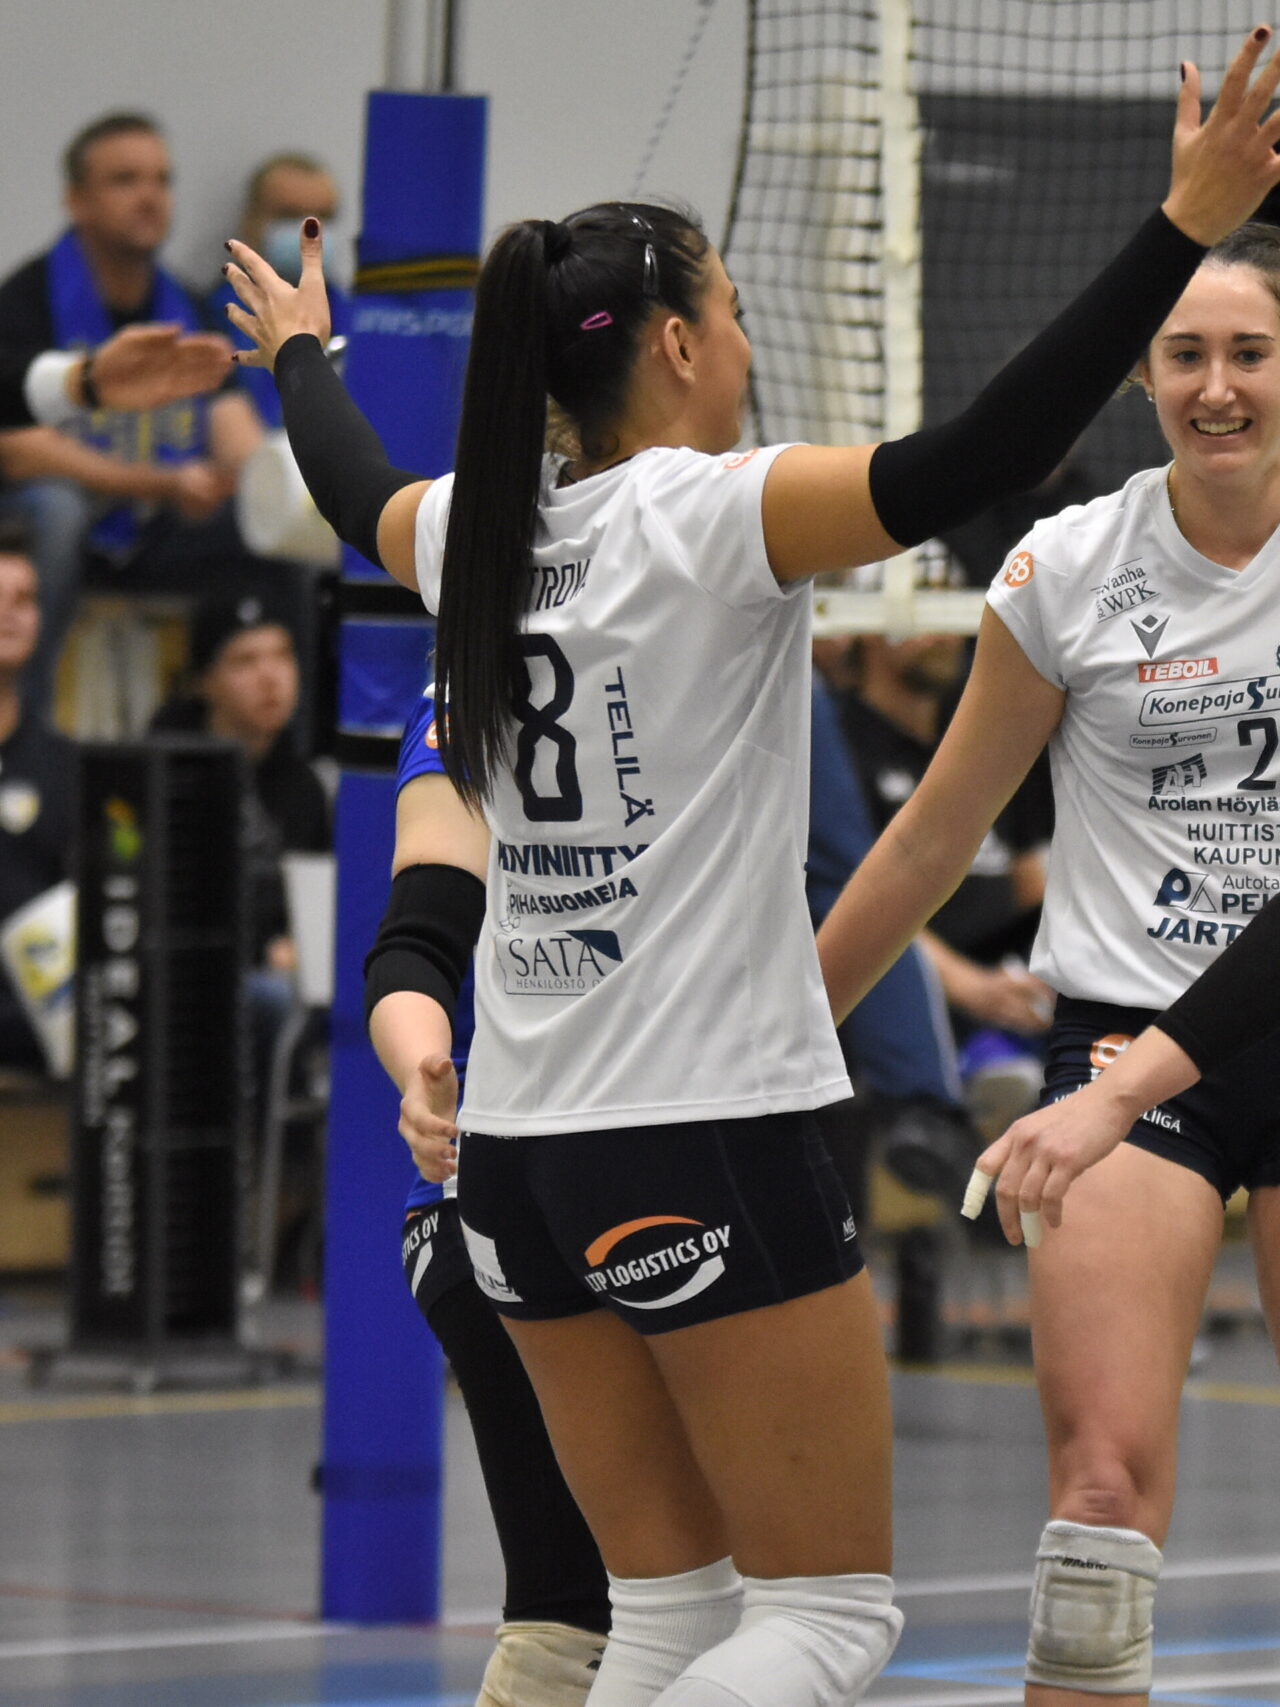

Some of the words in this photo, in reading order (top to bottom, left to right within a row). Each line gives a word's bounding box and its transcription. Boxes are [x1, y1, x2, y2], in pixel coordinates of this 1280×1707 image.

[1104, 567, 1147, 592] Vanha
[1143, 660, 1213, 681] TEBOIL
[1149, 689, 1245, 715] Konepaja
[512, 633, 583, 822] 8
[604, 666, 655, 828] TELILÄ
[1237, 717, 1279, 791] 2
[1148, 795, 1211, 811] Arolan
[509, 877, 638, 915] PIHASUOMELA
[509, 937, 606, 977] SATA
[606, 1238, 700, 1287] LOGISTICS
[702, 1225, 730, 1253] OY
